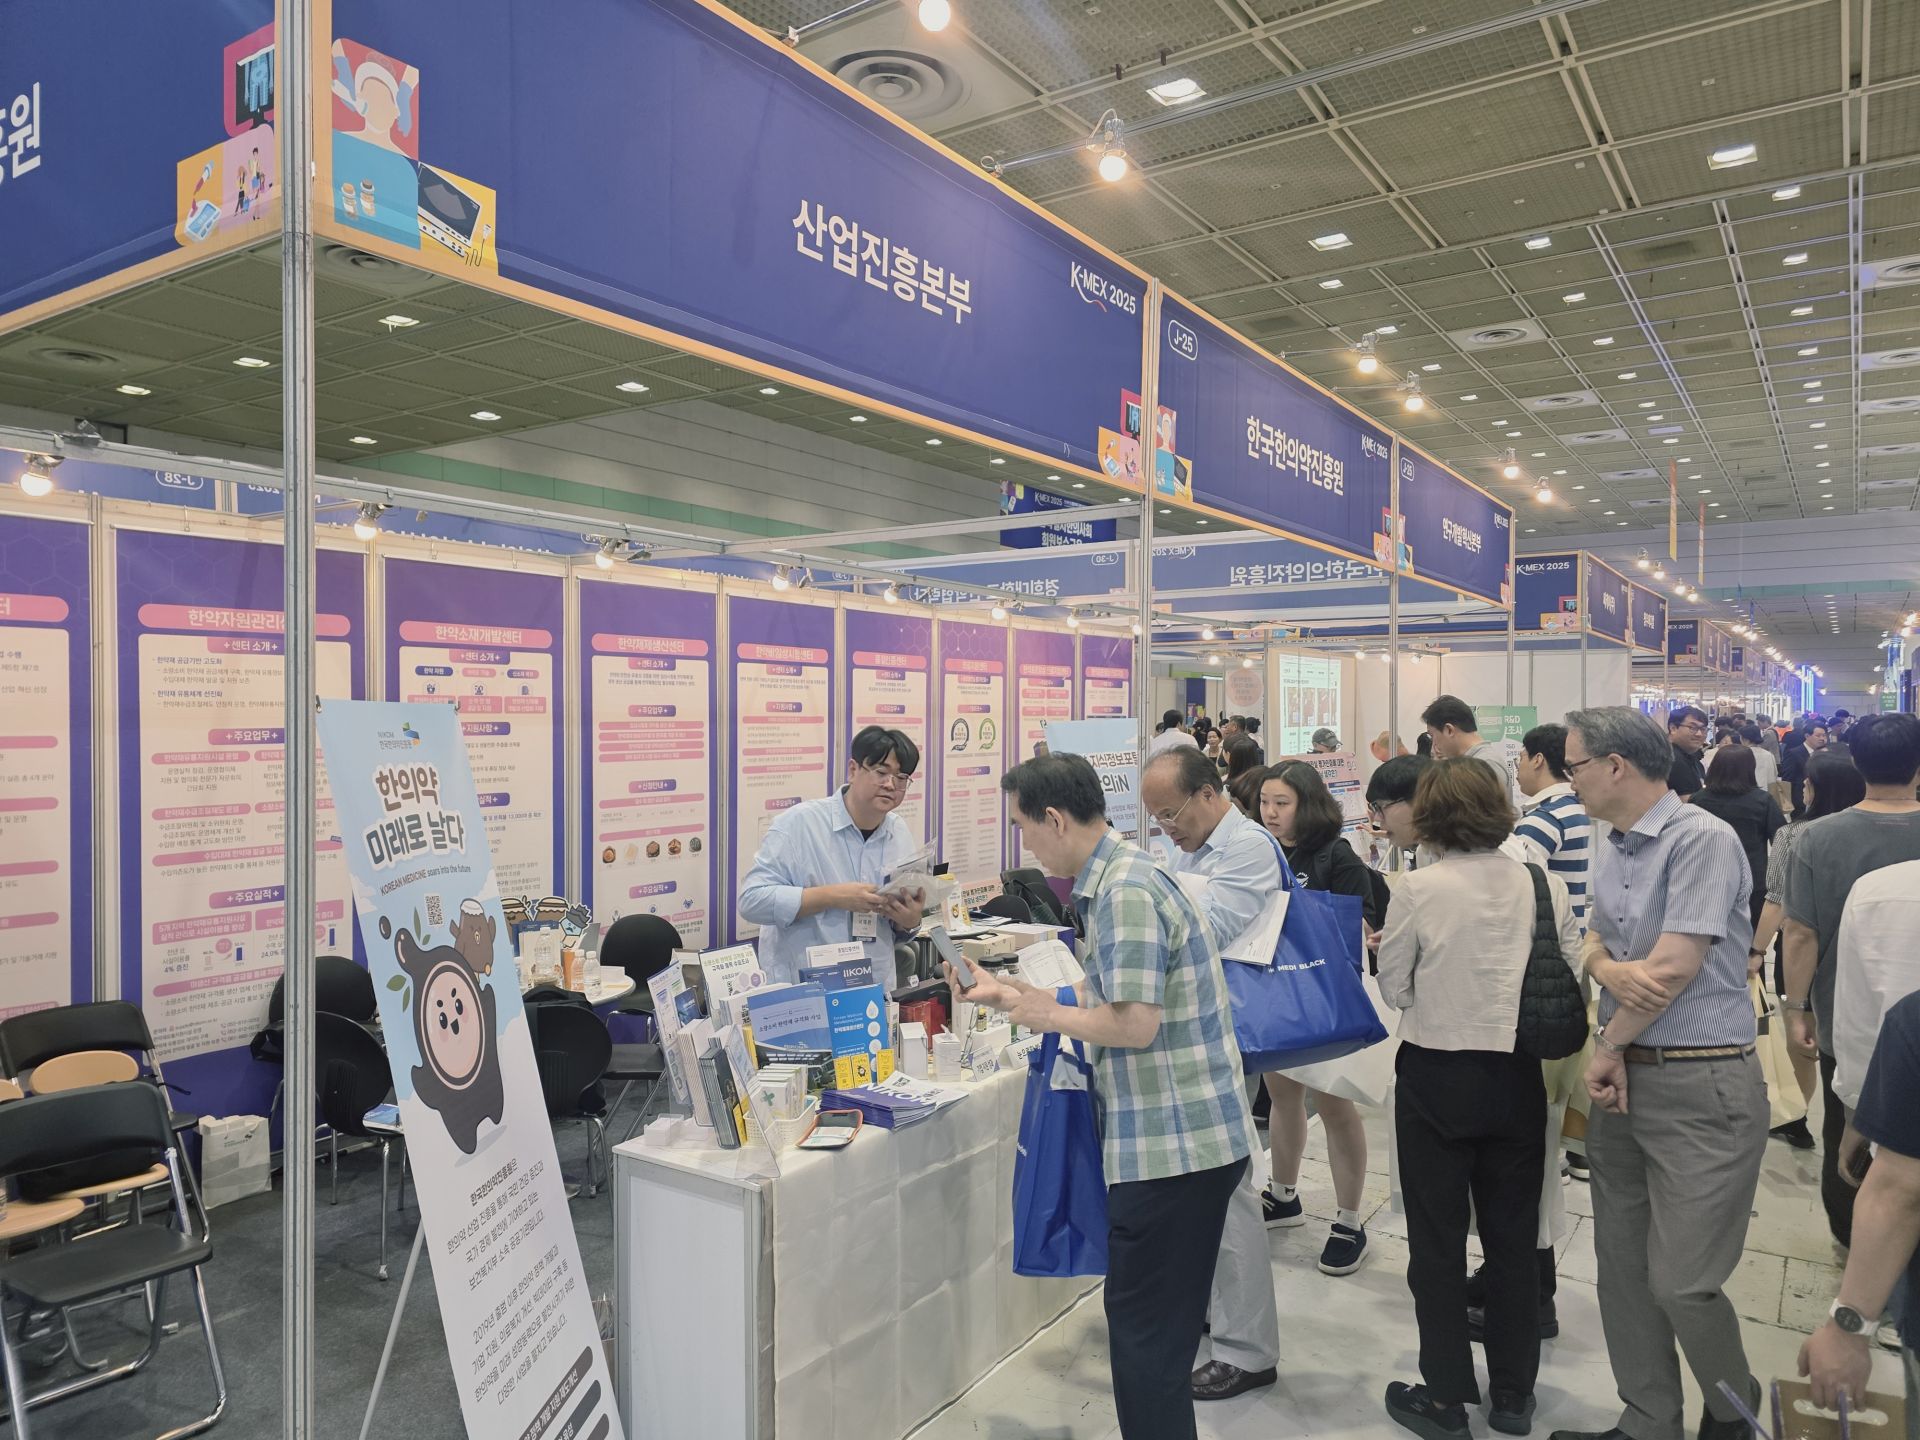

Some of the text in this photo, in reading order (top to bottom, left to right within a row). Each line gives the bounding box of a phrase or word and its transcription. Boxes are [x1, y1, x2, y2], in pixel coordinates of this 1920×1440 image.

[0, 81, 41, 186] 원
[792, 199, 972, 324] 산업진흥본부
[1070, 261, 1136, 315] K-MEX 2025
[1173, 329, 1193, 353] J-25
[1247, 415, 1344, 496] 한국한의약진흥원
[1516, 562, 1570, 575] K-MEX 2025
[231, 640, 271, 653] 센터 소개
[435, 625, 523, 645] 한약소재개발센터
[157, 656, 176, 665] 한약재
[465, 652, 495, 662] 센터 소개
[465, 724, 493, 733] 지원사항
[1504, 715, 1521, 724] R&D
[234, 731, 271, 742] 주요업무
[375, 766, 438, 812] 한의약
[1100, 773, 1131, 794] 의iN
[366, 810, 464, 865] 미래로 날다
[379, 864, 472, 897] KOREAN MEDICINE soars into the future
[642, 884, 665, 895] 주요실적
[235, 889, 272, 902] 주요실적
[1277, 958, 1326, 972] MEDI BLACK
[760, 1022, 778, 1033] 소량소비
[778, 1018, 794, 1029] 한약재
[810, 1013, 822, 1022] 사업
[858, 1082, 938, 1106] NIKOM
[470, 1158, 518, 1208] 한국한의약진흥원은
[447, 1228, 467, 1255] 한의약
[467, 1216, 480, 1237] 산업
[479, 1202, 497, 1226] 진흥을
[507, 1181, 520, 1198] 국민
[465, 1244, 479, 1264] 국가
[507, 1198, 529, 1226] 기여하고
[468, 1254, 498, 1292] 보건복지부
[498, 1243, 511, 1263] 소속
[472, 1312, 495, 1345] 2019년
[507, 1287, 519, 1307] 이후
[517, 1270, 534, 1295] 한의약
[472, 1352, 486, 1375] 기업
[499, 1311, 522, 1345] 의료복지
[474, 1365, 500, 1403] 한의약을
[498, 1350, 512, 1374] 미래
[497, 1377, 516, 1406] 다양한
[515, 1354, 533, 1385] 사업을
